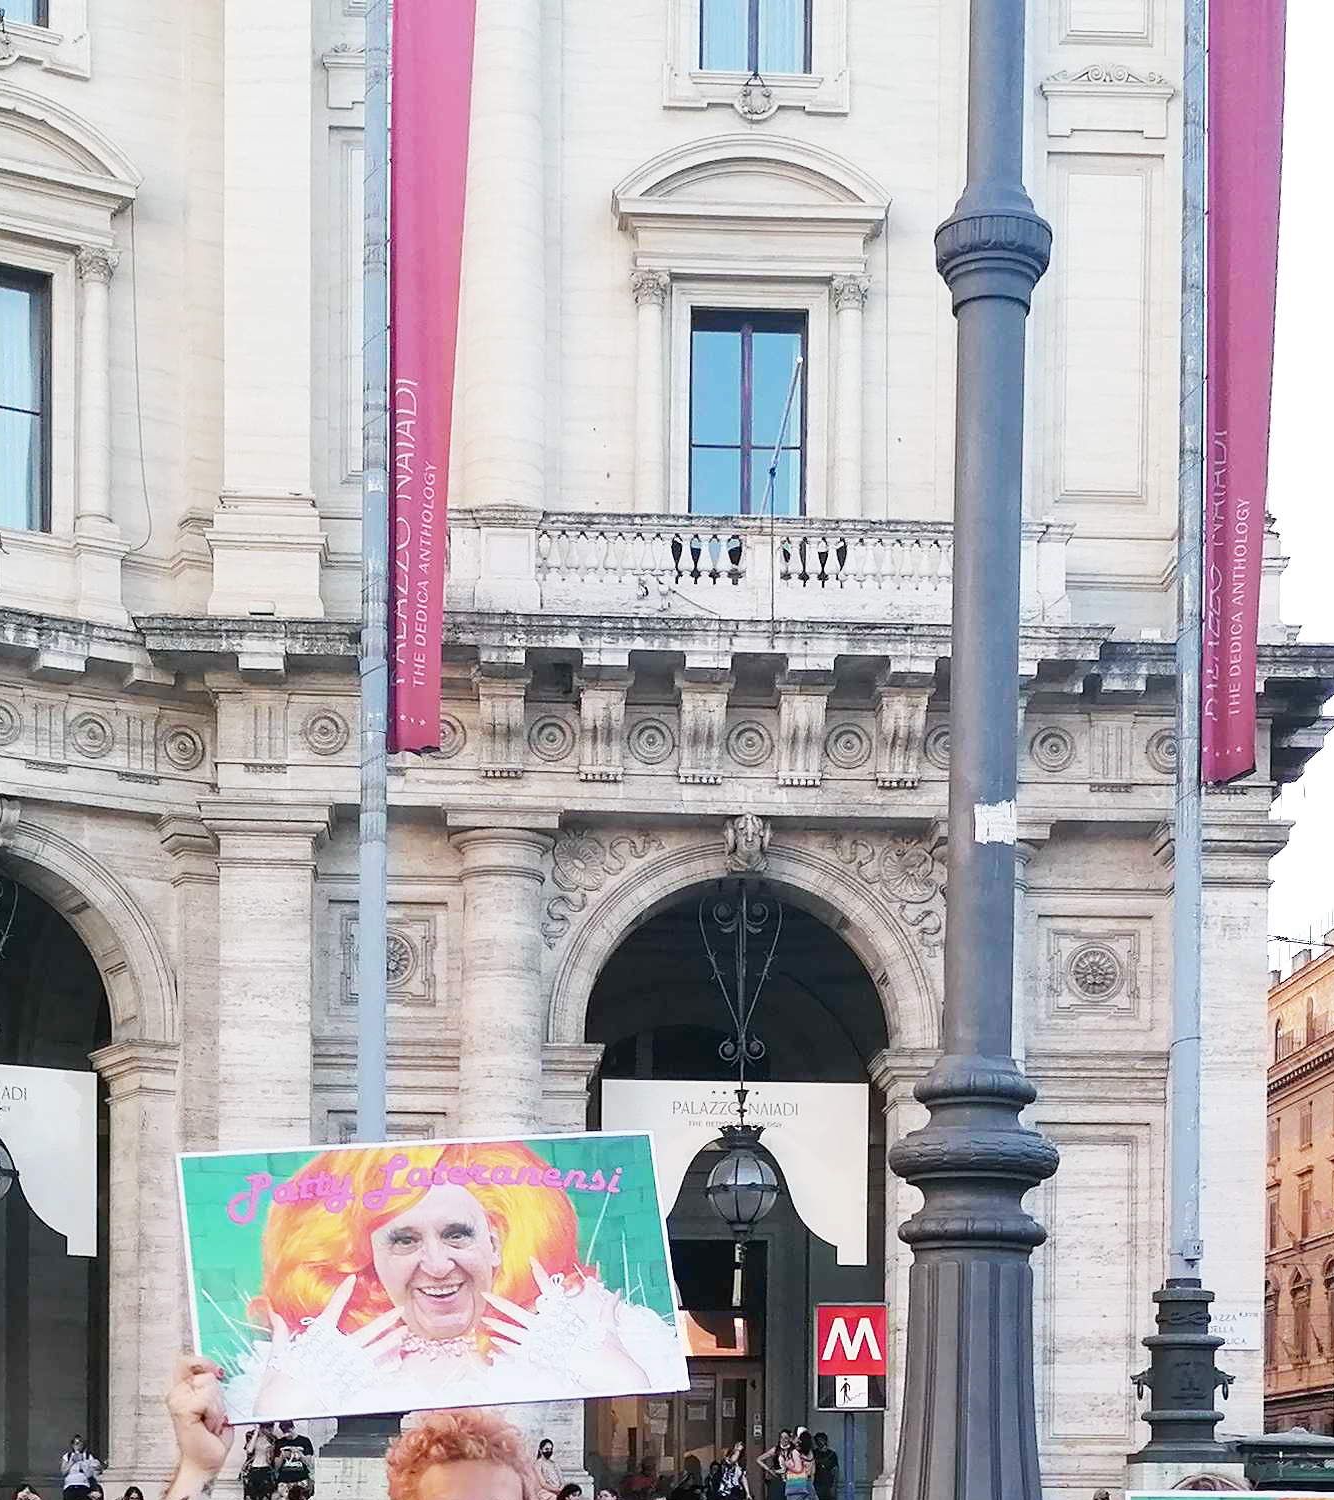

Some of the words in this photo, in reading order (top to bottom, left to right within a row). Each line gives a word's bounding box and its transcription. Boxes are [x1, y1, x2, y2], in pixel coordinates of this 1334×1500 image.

[394, 377, 419, 501] NAIADI
[418, 460, 438, 575] ANTHOLOGY
[1231, 497, 1251, 606] ANTHOLOGY
[413, 579, 430, 648] DEDICA
[1229, 610, 1244, 678] DEDICA
[412, 651, 427, 688] THE
[1228, 680, 1242, 716] THE
[671, 1101, 740, 1116] PALAZZO
[747, 1101, 799, 1117] NAIADI
[227, 1170, 355, 1227] Patty
[362, 1153, 624, 1211] Lateranensi
[822, 1317, 882, 1361] M
